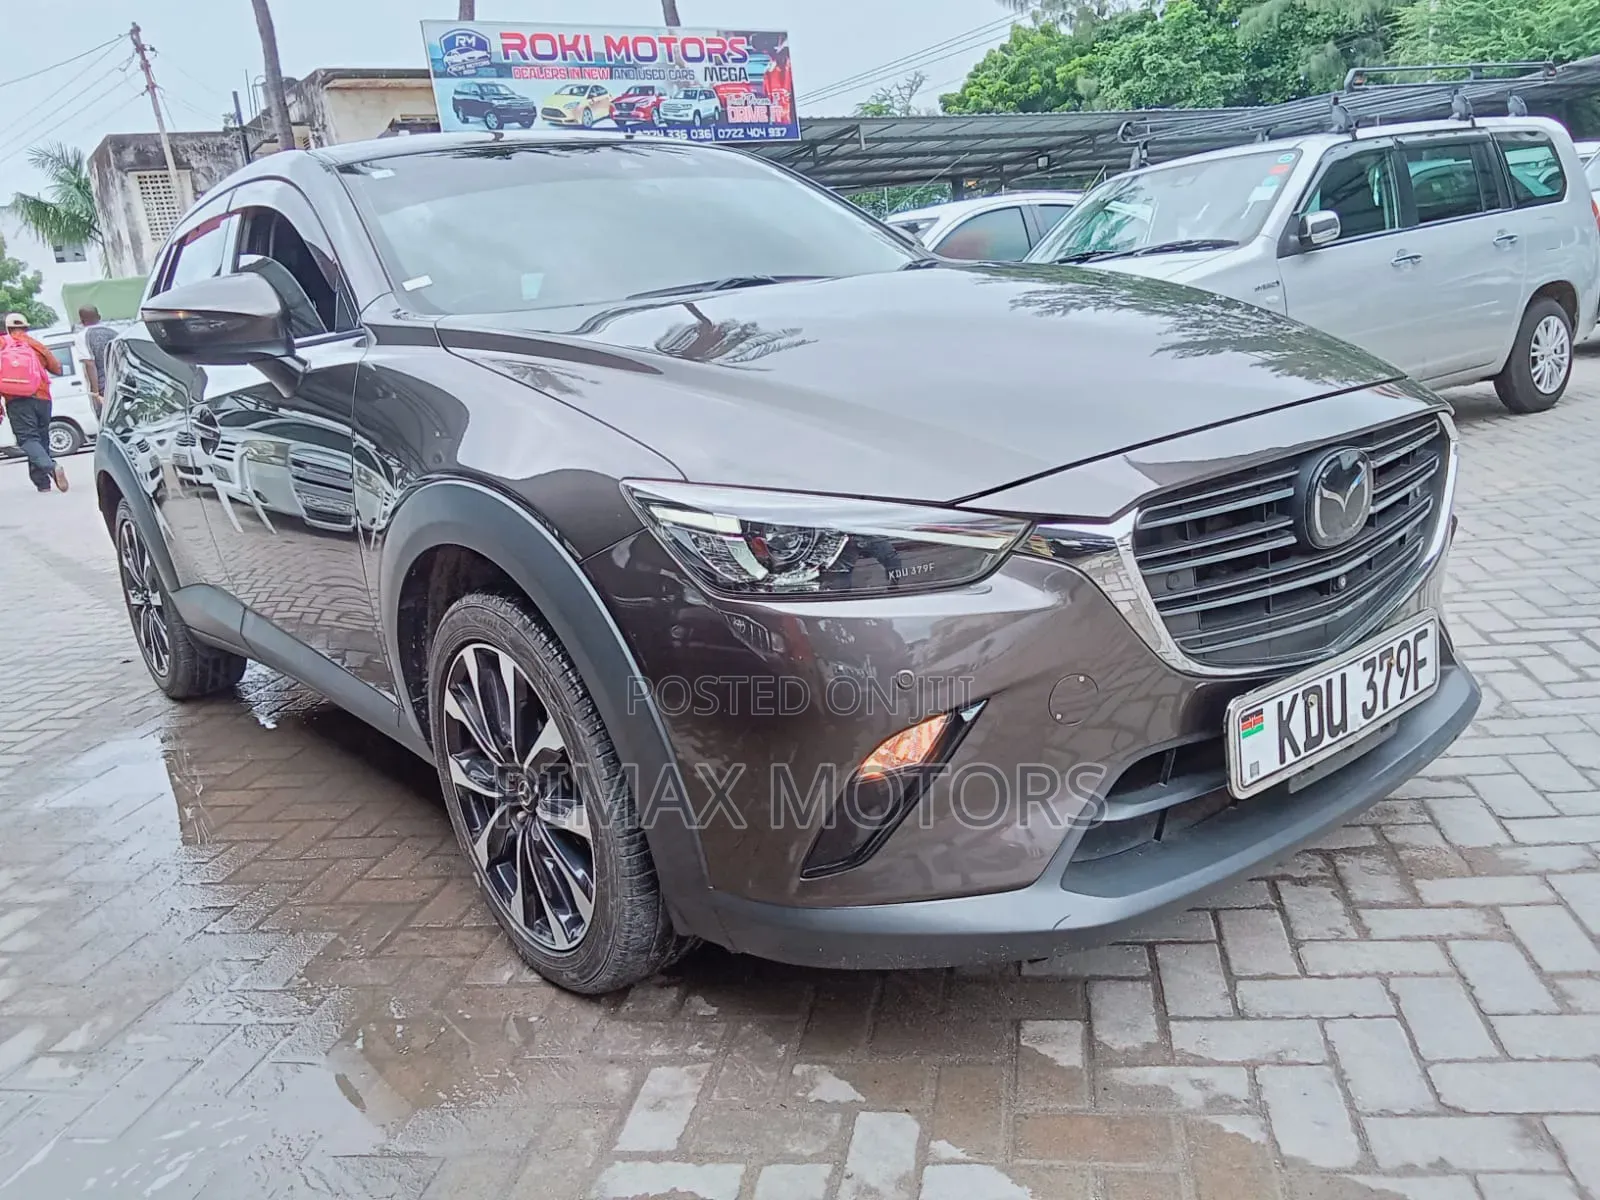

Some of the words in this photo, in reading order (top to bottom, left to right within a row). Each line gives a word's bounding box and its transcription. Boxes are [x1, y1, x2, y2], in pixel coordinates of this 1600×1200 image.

[455, 35, 477, 48] RM
[499, 32, 594, 63] ROKI
[603, 35, 750, 65] MOTORS
[512, 66, 567, 80] DEALERS
[568, 67, 581, 80] IN
[582, 67, 611, 80] NEW
[612, 67, 636, 80] AND
[638, 68, 667, 80] USED
[668, 68, 696, 80] CARS
[704, 66, 749, 82] MEGA
[666, 129, 688, 140] 336
[690, 129, 712, 140] 036
[718, 128, 744, 138] 0722
[746, 127, 767, 137] 404
[767, 127, 787, 137] 937
[888, 567, 909, 580] KDU
[911, 562, 935, 575] 379F
[1277, 672, 1348, 766] KDU
[1361, 628, 1428, 720] 379F
